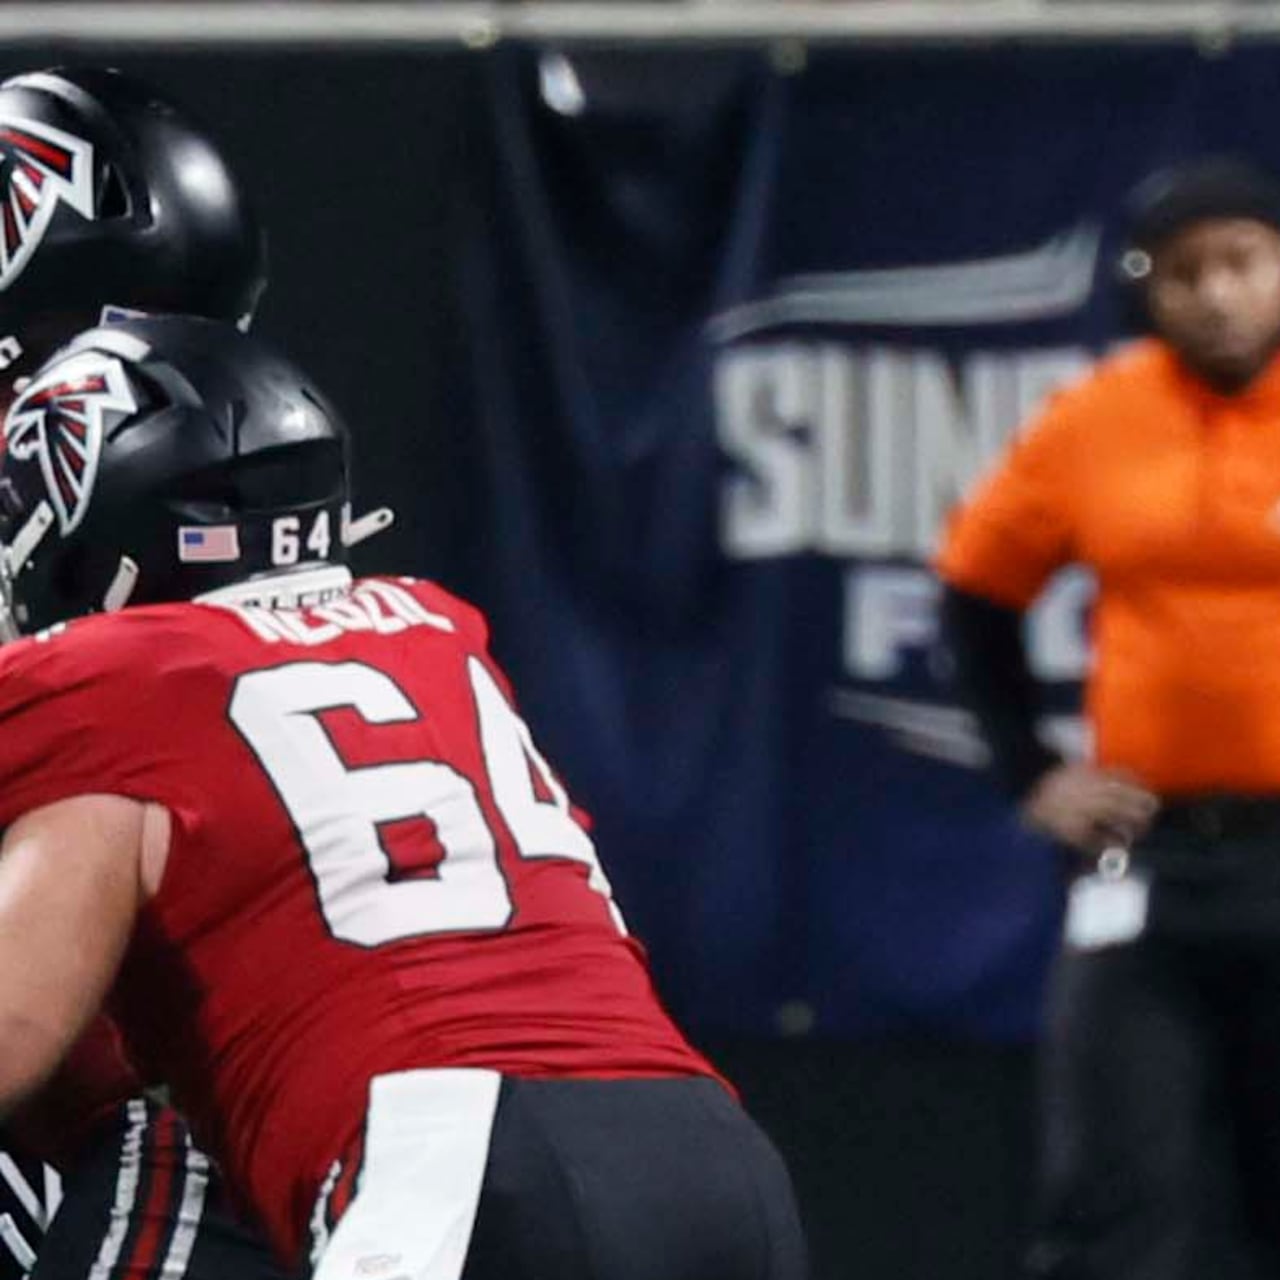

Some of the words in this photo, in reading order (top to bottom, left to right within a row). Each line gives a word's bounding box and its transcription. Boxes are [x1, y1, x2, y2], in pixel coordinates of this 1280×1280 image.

[272, 510, 331, 565] 64
[713, 343, 1098, 562] SUN
[228, 655, 629, 948] 64
